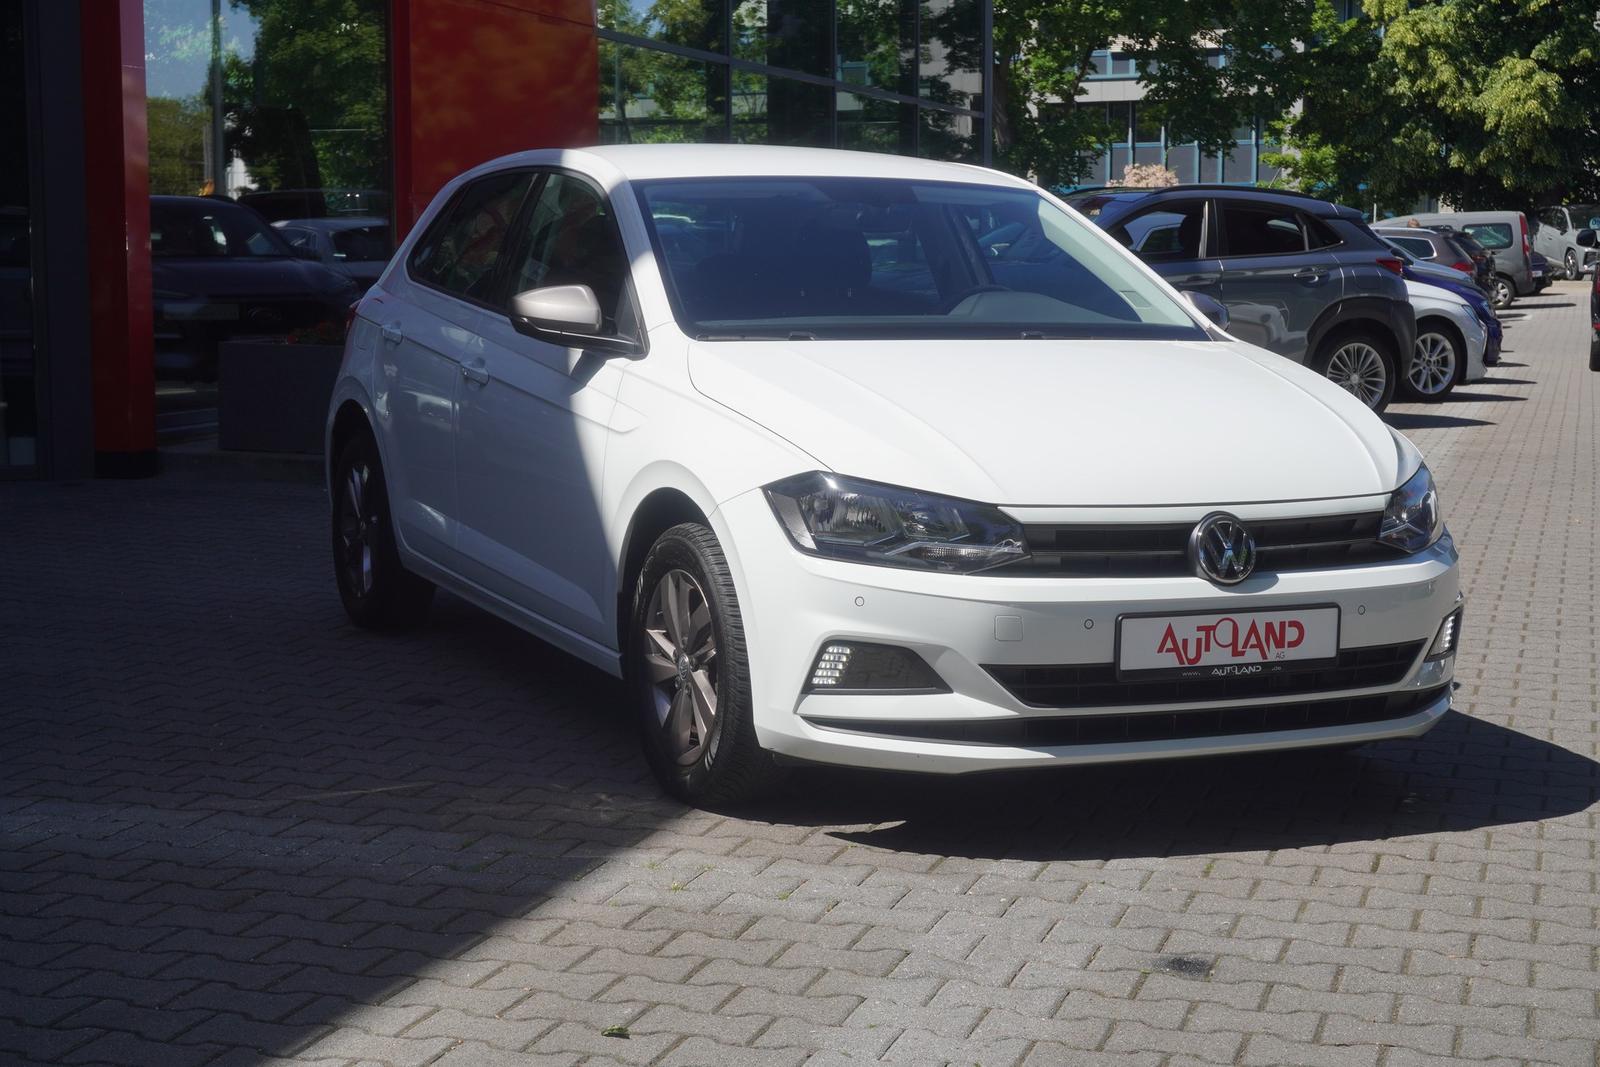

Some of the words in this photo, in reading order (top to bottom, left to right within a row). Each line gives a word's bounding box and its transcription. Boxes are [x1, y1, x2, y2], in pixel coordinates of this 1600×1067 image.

[1157, 617, 1306, 665] AUTOLAND
[1275, 651, 1286, 660] AG
[1211, 664, 1263, 676] AUTOLAND
